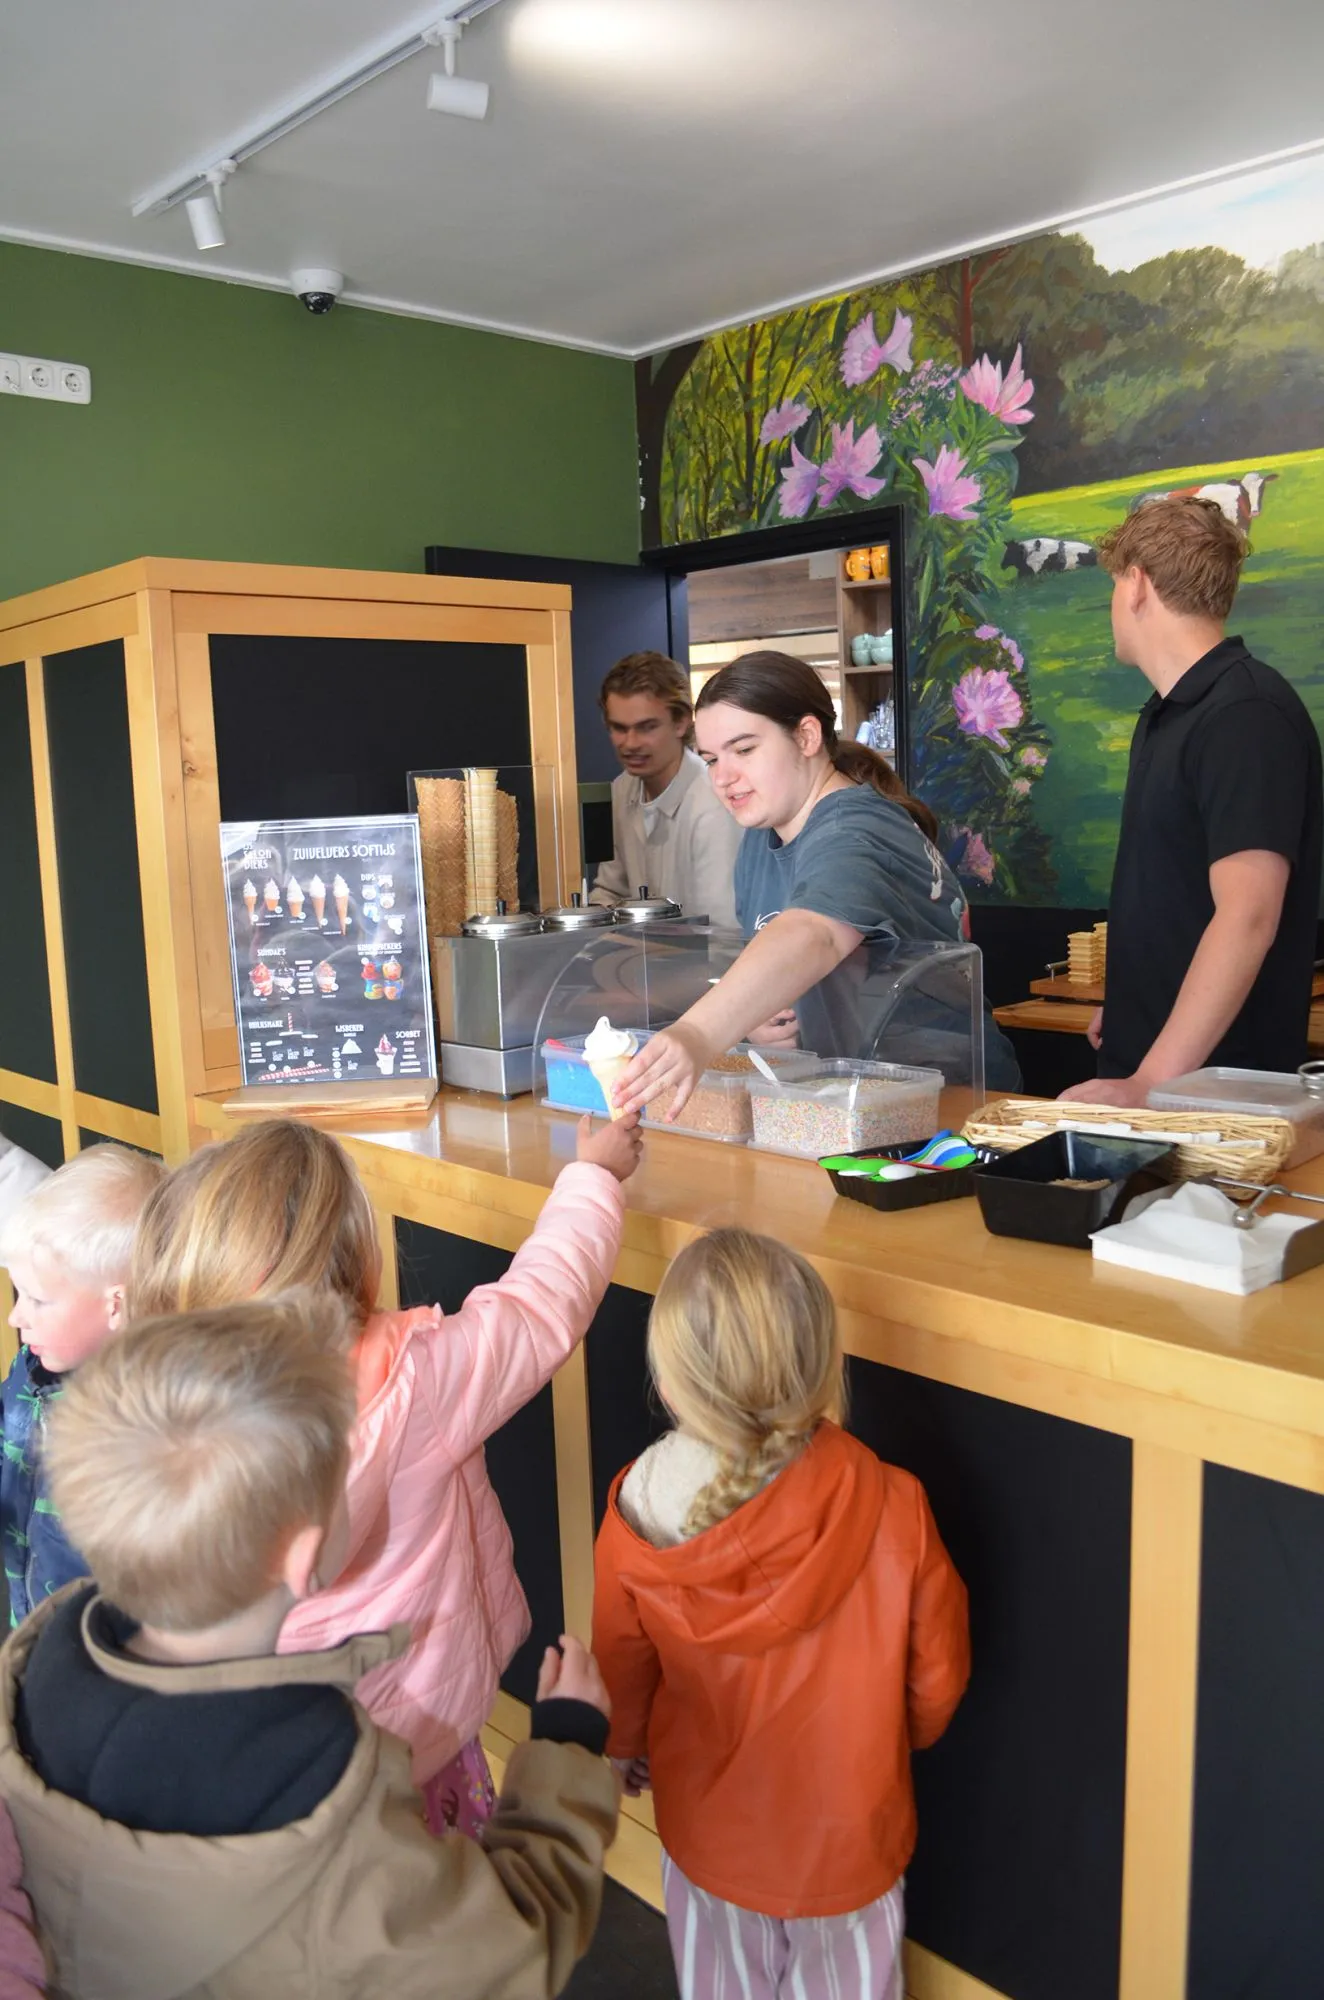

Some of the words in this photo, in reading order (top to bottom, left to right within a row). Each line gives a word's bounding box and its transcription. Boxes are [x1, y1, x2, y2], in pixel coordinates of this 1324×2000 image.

[292, 846, 350, 860] ZUIVELVERS
[352, 843, 396, 858] SOFTIJS
[361, 873, 376, 881] DIPS
[395, 1030, 421, 1039] SORBET
